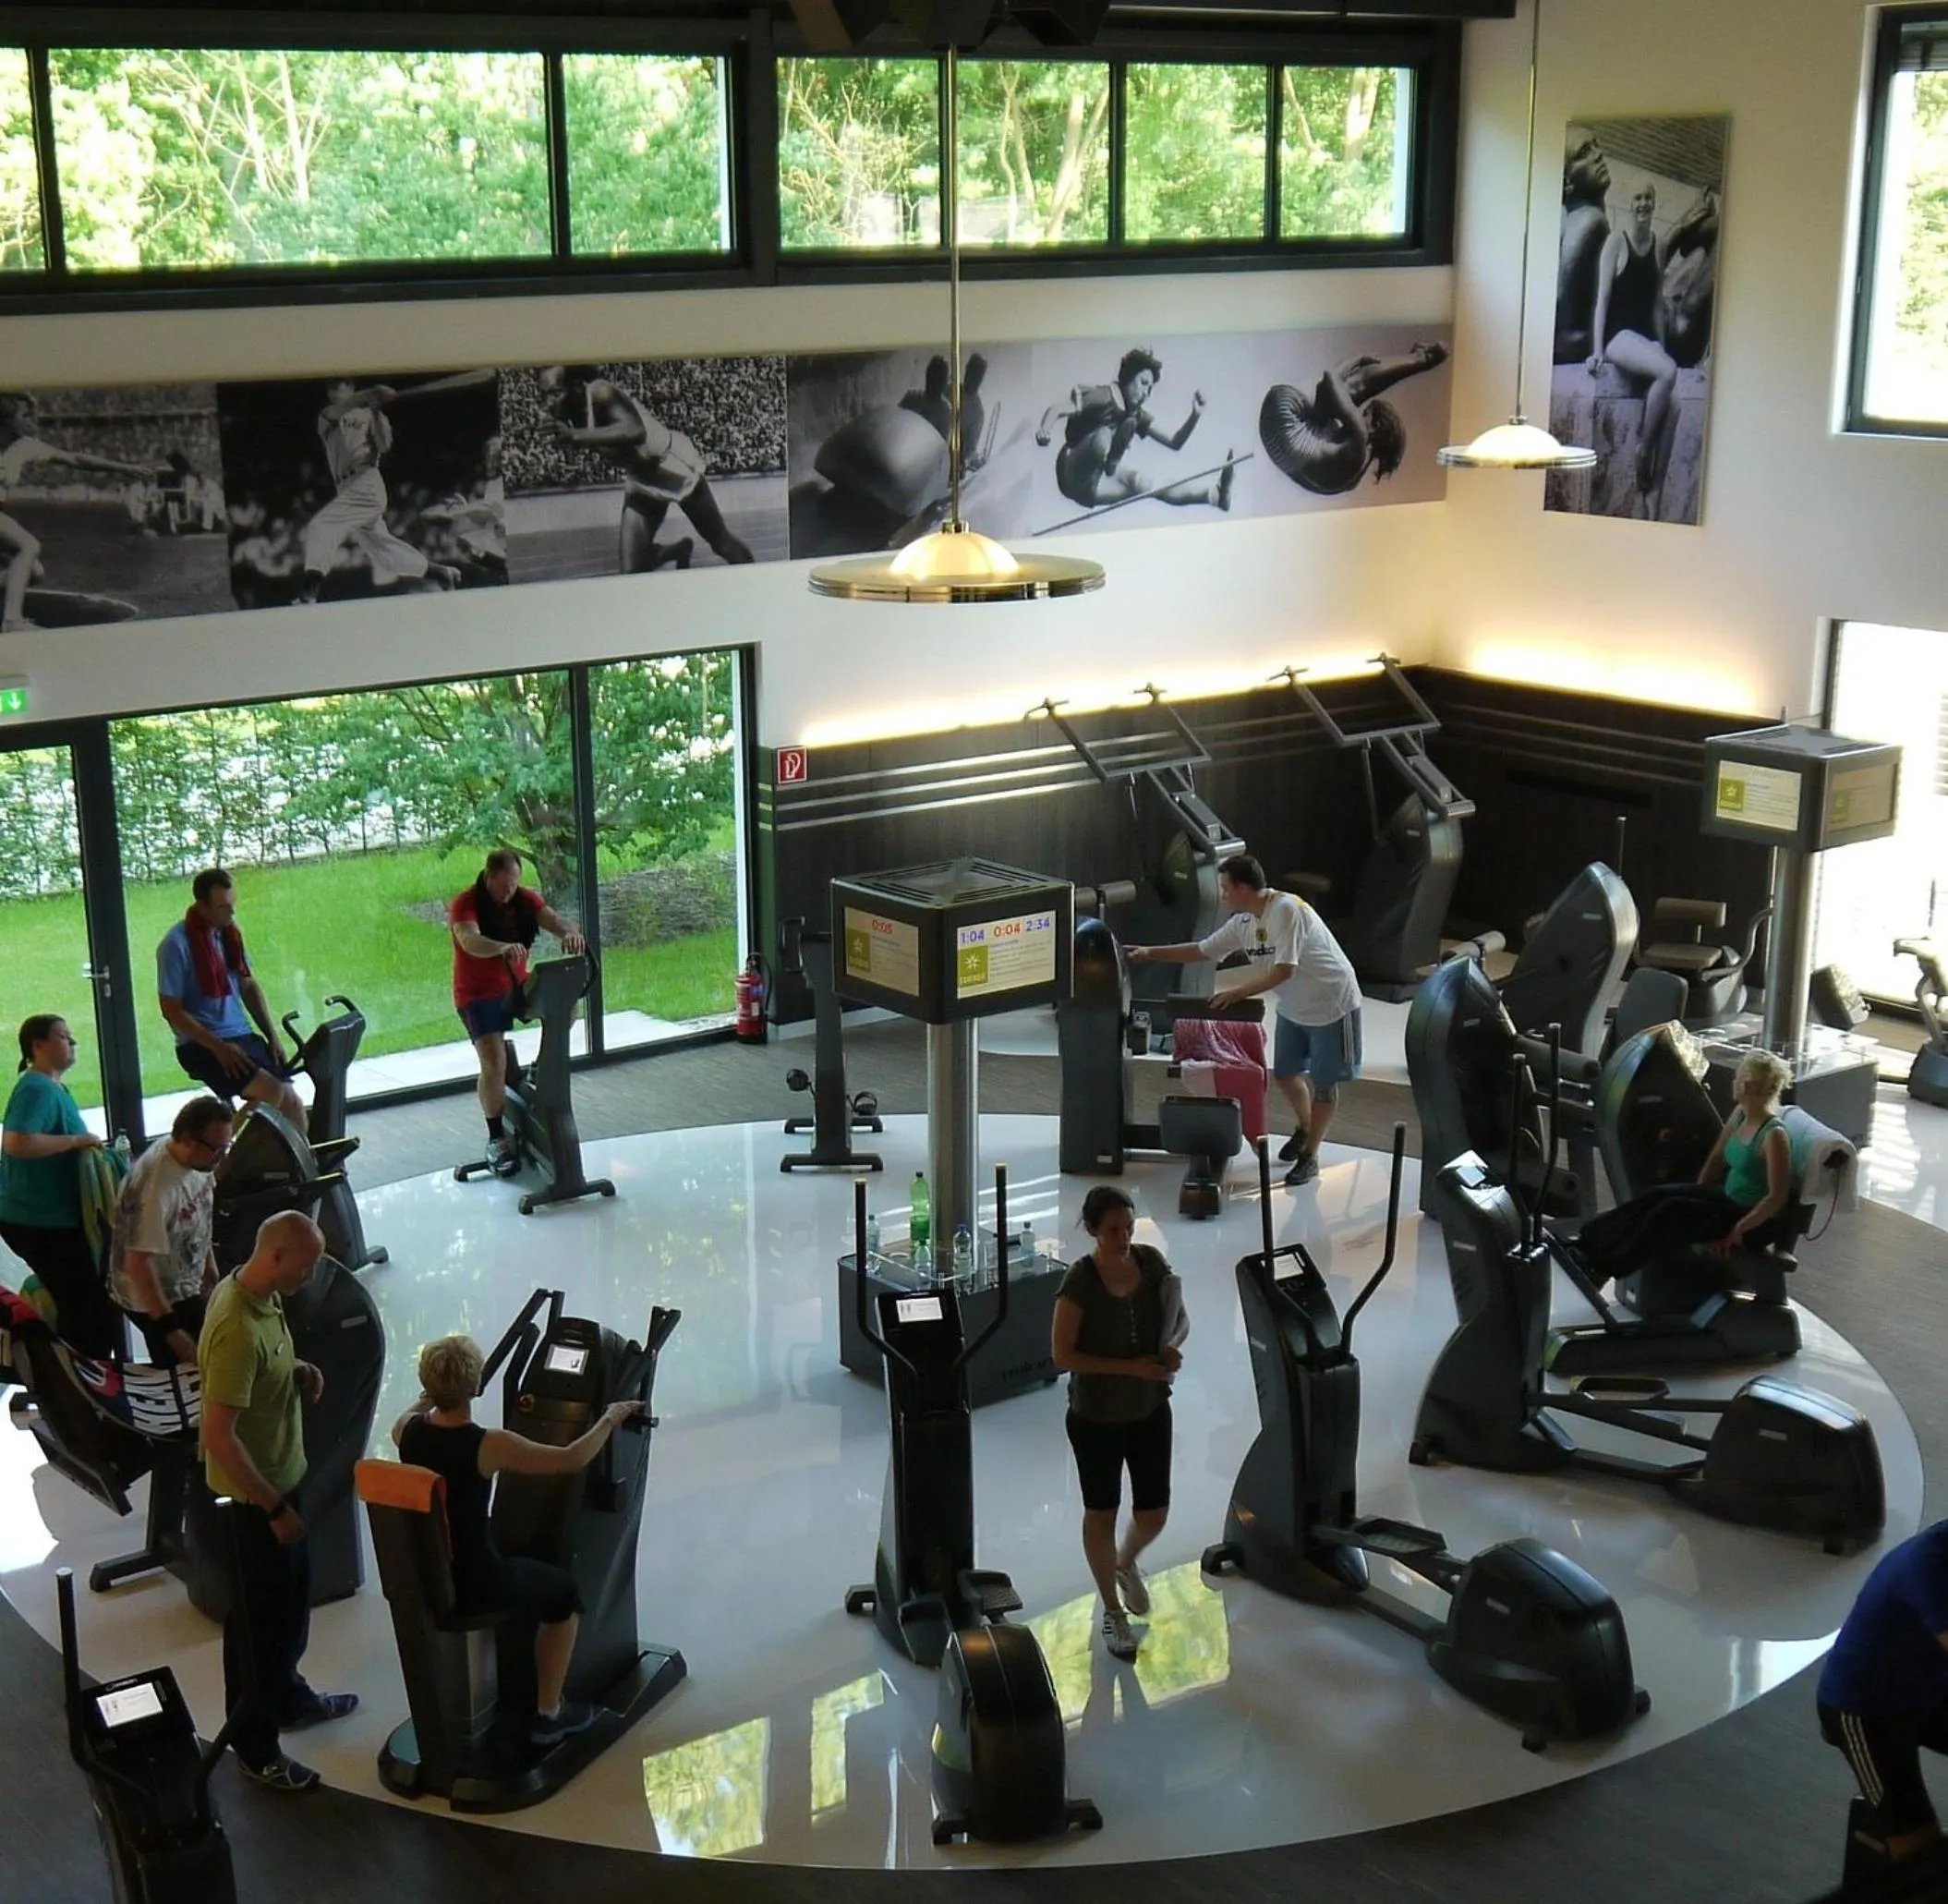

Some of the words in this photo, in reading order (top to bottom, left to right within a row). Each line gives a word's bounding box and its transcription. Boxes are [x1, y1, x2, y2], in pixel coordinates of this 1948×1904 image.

[961, 928, 986, 943] 1:04
[993, 922, 1021, 938] 0:04
[1025, 916, 1051, 932] 2:34
